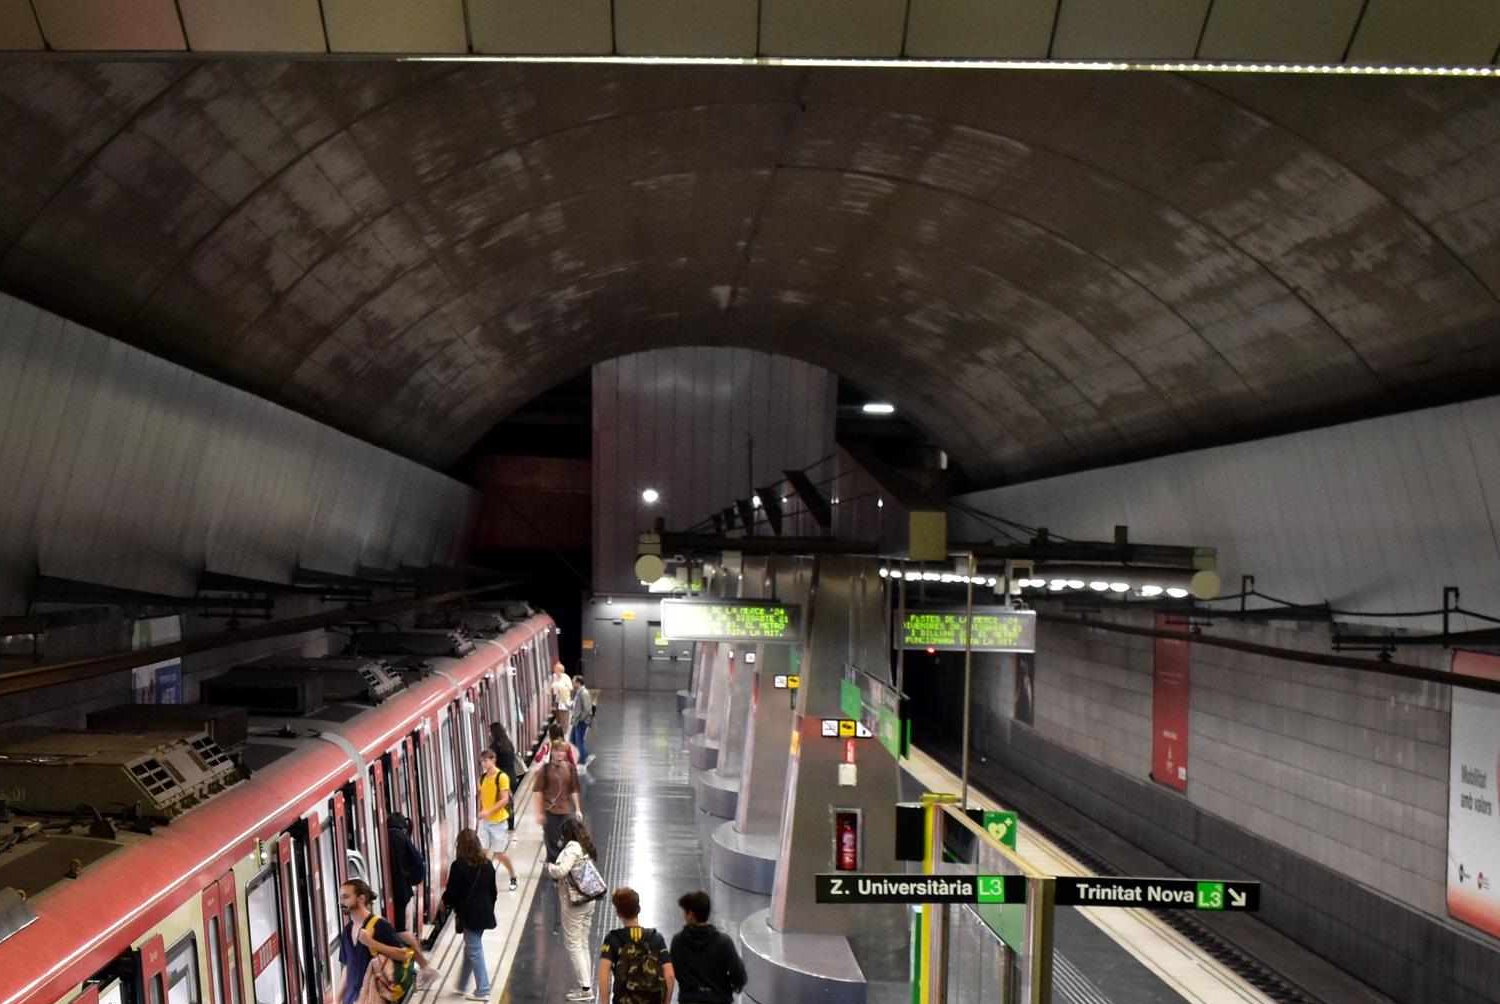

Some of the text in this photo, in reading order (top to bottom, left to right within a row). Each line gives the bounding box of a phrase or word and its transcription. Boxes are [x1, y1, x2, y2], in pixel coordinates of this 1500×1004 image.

[830, 878, 1002, 896] Z. Universitària L3
[1076, 883, 1222, 907] Trinitat Nova L3
